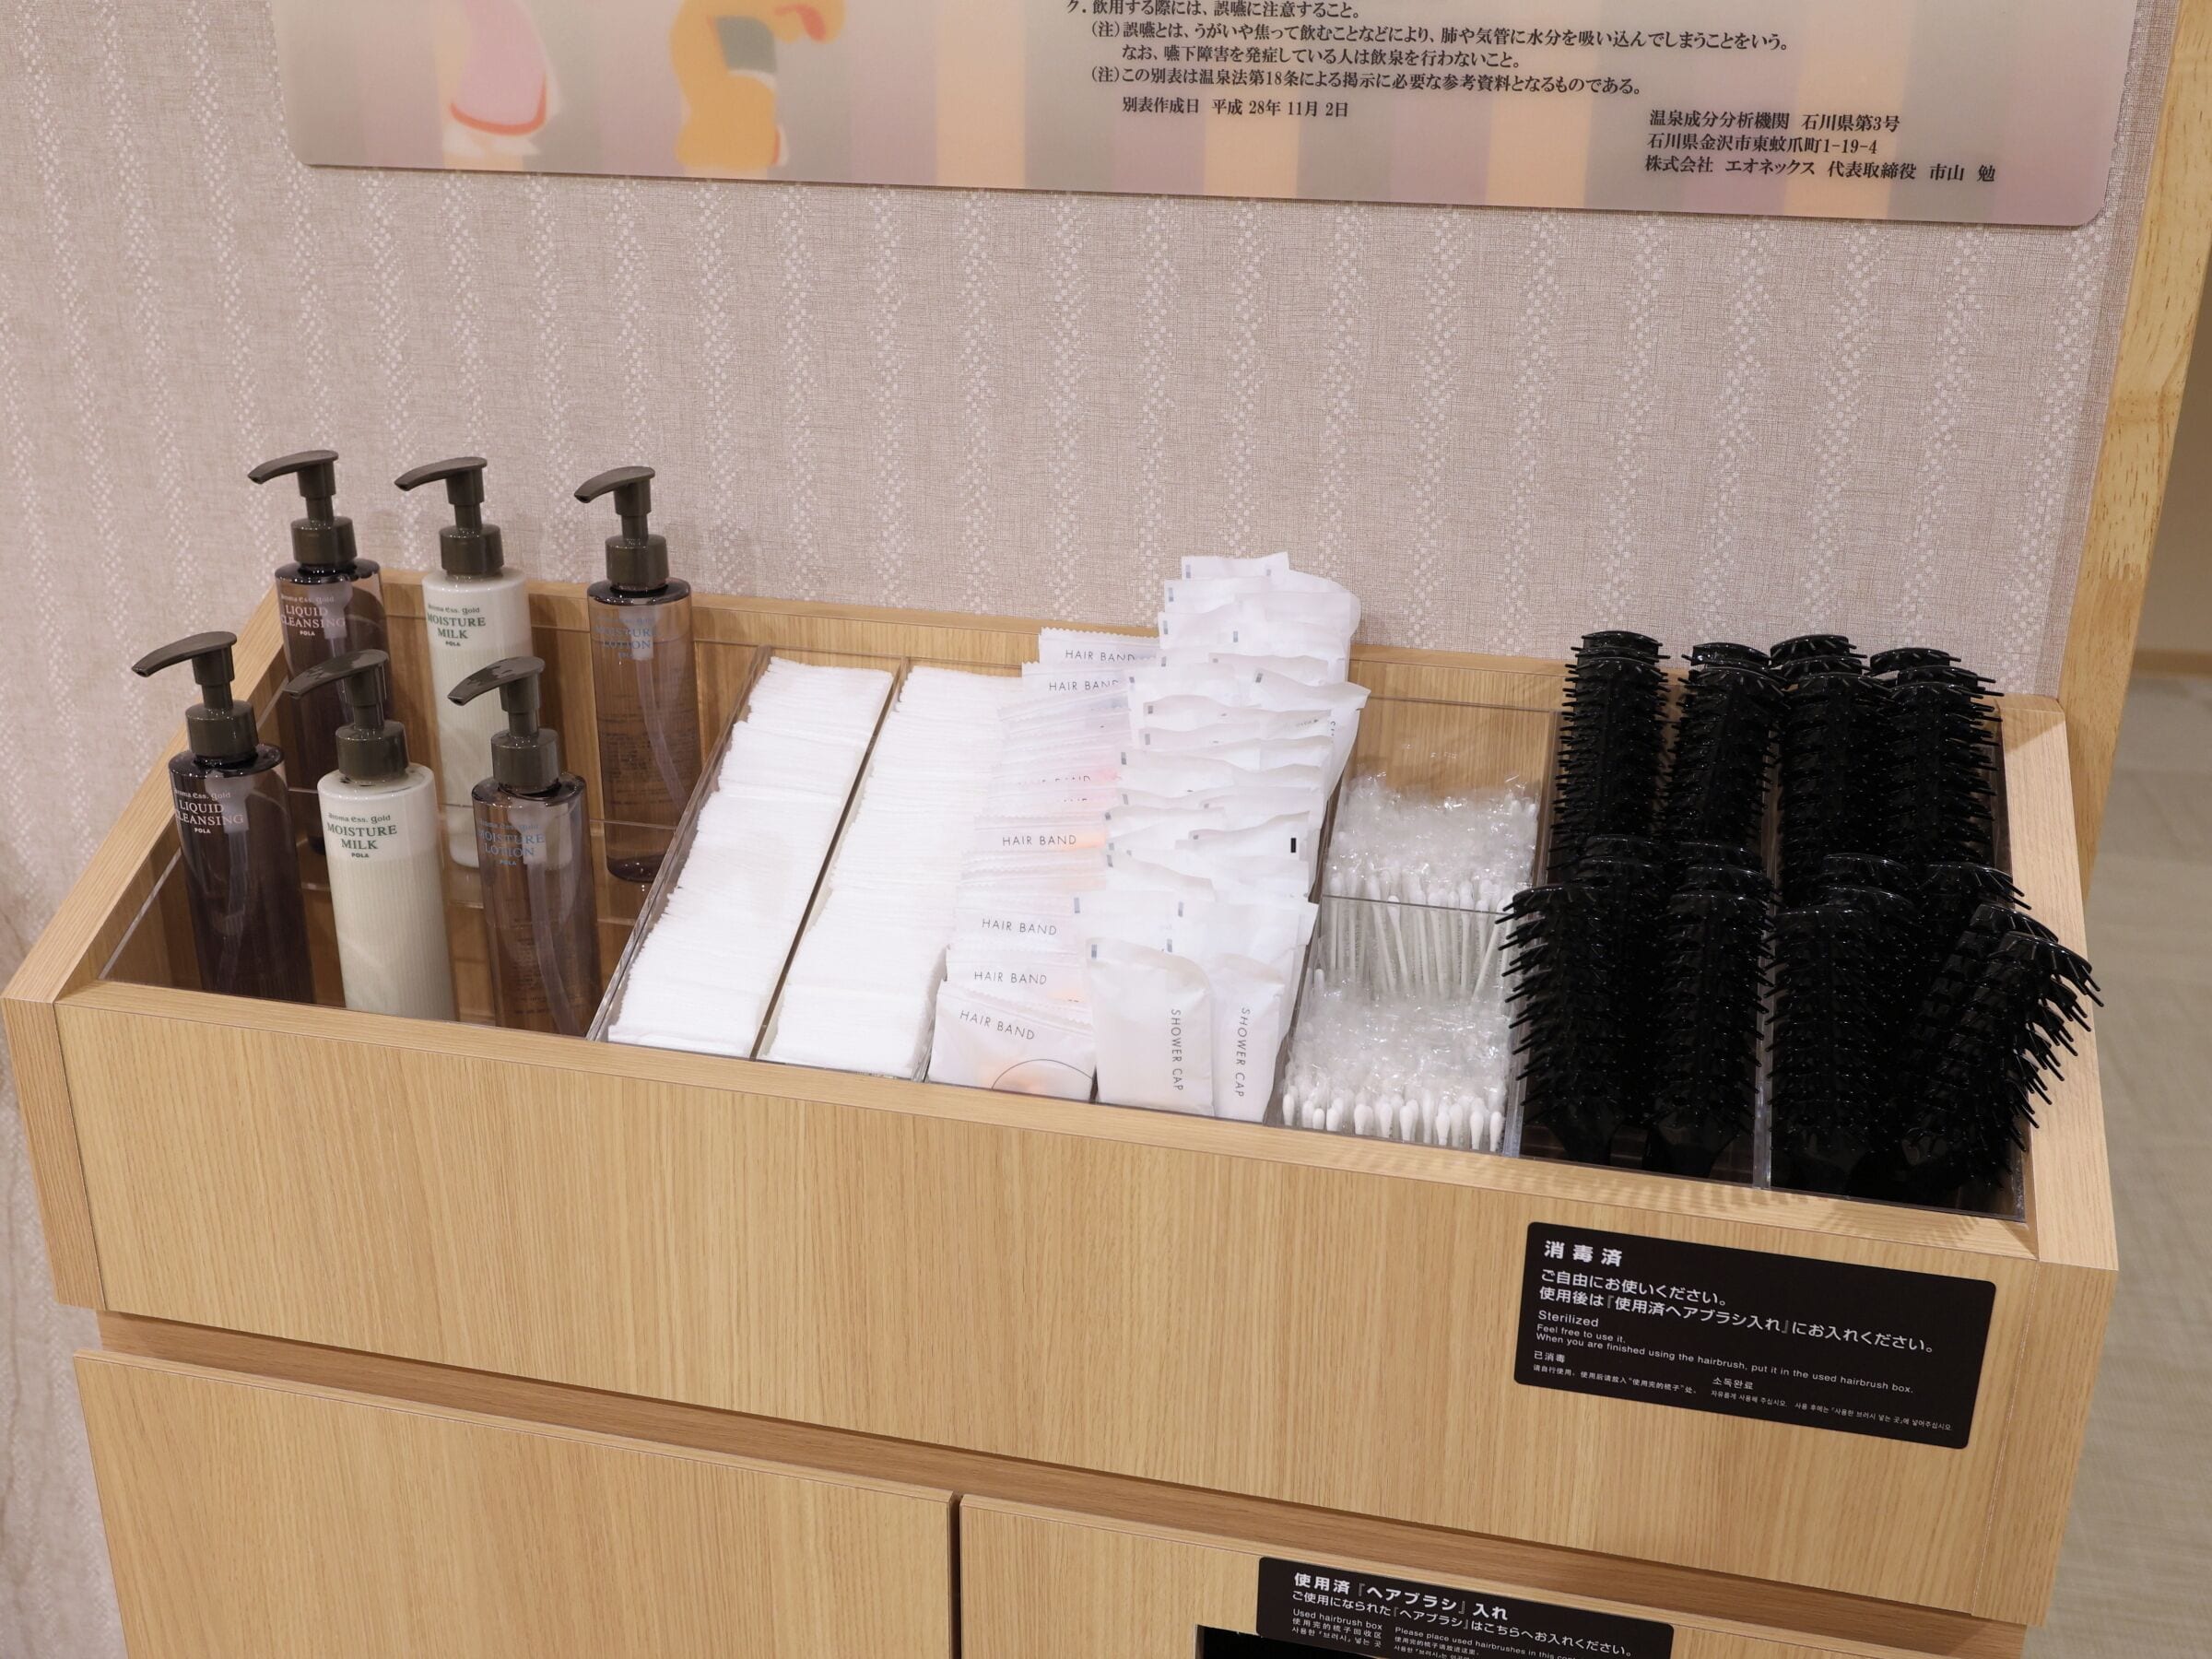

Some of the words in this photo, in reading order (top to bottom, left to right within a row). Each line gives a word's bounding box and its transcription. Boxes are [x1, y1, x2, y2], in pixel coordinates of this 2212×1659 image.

[1122, 97, 1199, 113] 別表作成日
[1212, 99, 1242, 115] 平成
[1249, 100, 1281, 116] 28年
[1288, 100, 1318, 117] 11月
[1325, 101, 1348, 118] 2日
[1650, 109, 1790, 130] 温泉成分分析機関
[1801, 113, 1900, 133] 石川県第3号
[1646, 133, 1878, 155] 石川県金沢市東蚊爪町1-19-4
[1644, 155, 1714, 173] 株式会社
[1724, 159, 1817, 177] エオネックス
[1828, 161, 1917, 181] 代表取締役
[1929, 163, 1965, 182] 市山
[1977, 164, 1996, 182] 勉
[285, 605, 329, 618] LIQUID
[427, 612, 487, 627] MOISTURE
[438, 628, 468, 639] MILK
[1065, 649, 1094, 660] HAIR
[1049, 681, 1077, 691] HAIR
[179, 799, 225, 815] LIQUID
[326, 821, 398, 838] MOISTURE
[341, 839, 379, 850] MILK
[485, 842, 535, 857] LOTION
[1002, 835, 1032, 846] HAIR
[1040, 834, 1077, 846] BAND
[982, 918, 1012, 931] HAIR
[1019, 923, 1057, 935] BAND
[974, 971, 1003, 982] HAIR
[1010, 972, 1047, 984] BAND
[959, 1010, 991, 1028] HAIR
[997, 1020, 1035, 1040] BAND
[1171, 1008, 1182, 1062] SHOWER
[1236, 1007, 1251, 1065] SHOWER
[1172, 1068, 1183, 1090] CAP
[1234, 1072, 1245, 1097] CAP
[1544, 1240, 1622, 1267] 消毒済
[1541, 1268, 1726, 1306] ご自由にお使いください。
[1538, 1310, 1599, 1327] Sterilized
[1536, 1324, 1558, 1334] Feel
[1561, 1327, 1580, 1336] free
[1583, 1330, 1593, 1338] to
[1536, 1333, 1563, 1344] When
[1567, 1338, 1584, 1347] you
[1587, 1341, 1603, 1349] are
[1606, 1343, 1645, 1356] finished
[1649, 1349, 1676, 1361] using
[1678, 1353, 1694, 1363] the
[1698, 1356, 1747, 1371] hairbrush,
[1751, 1364, 1768, 1374] put
[1771, 1366, 1777, 1374] it
[1780, 1367, 1789, 1376] in
[1793, 1369, 1808, 1379] the
[1812, 1372, 1837, 1382] used
[1840, 1376, 1888, 1390] hairbrush
[1891, 1382, 1913, 1394] box.
[1712, 1377, 1754, 1390] 소독완료
[1294, 1572, 1350, 1595] 使用済
[1473, 1603, 1508, 1621] 入れ
[1292, 1608, 1316, 1618] Used
[1319, 1612, 1363, 1627] hairbrush
[1365, 1620, 1382, 1630] box
[1394, 1626, 1424, 1638] Please
[1426, 1631, 1450, 1641] place
[1452, 1637, 1473, 1646] used
[1475, 1640, 1526, 1656] hairbrushes
[1538, 1650, 1555, 1659] this
